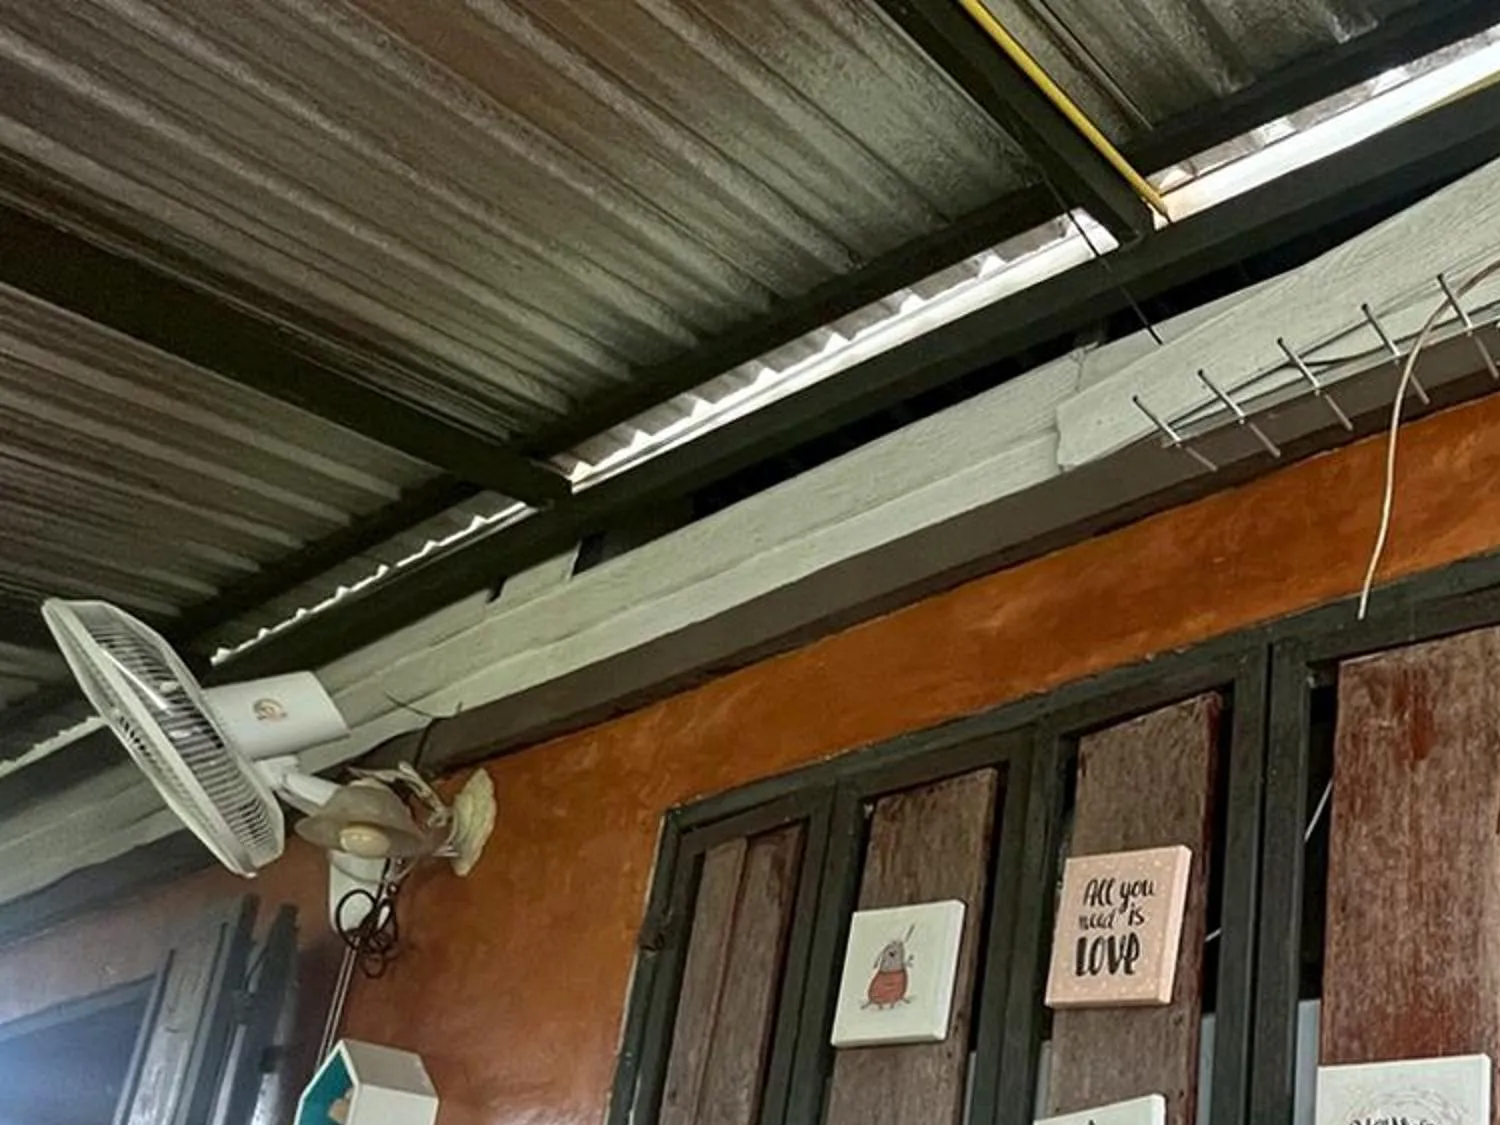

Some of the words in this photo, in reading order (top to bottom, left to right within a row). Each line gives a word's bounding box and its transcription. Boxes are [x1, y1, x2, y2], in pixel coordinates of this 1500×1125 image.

[1083, 878, 1116, 906] All
[1119, 879, 1155, 913] you
[1128, 903, 1145, 926] is
